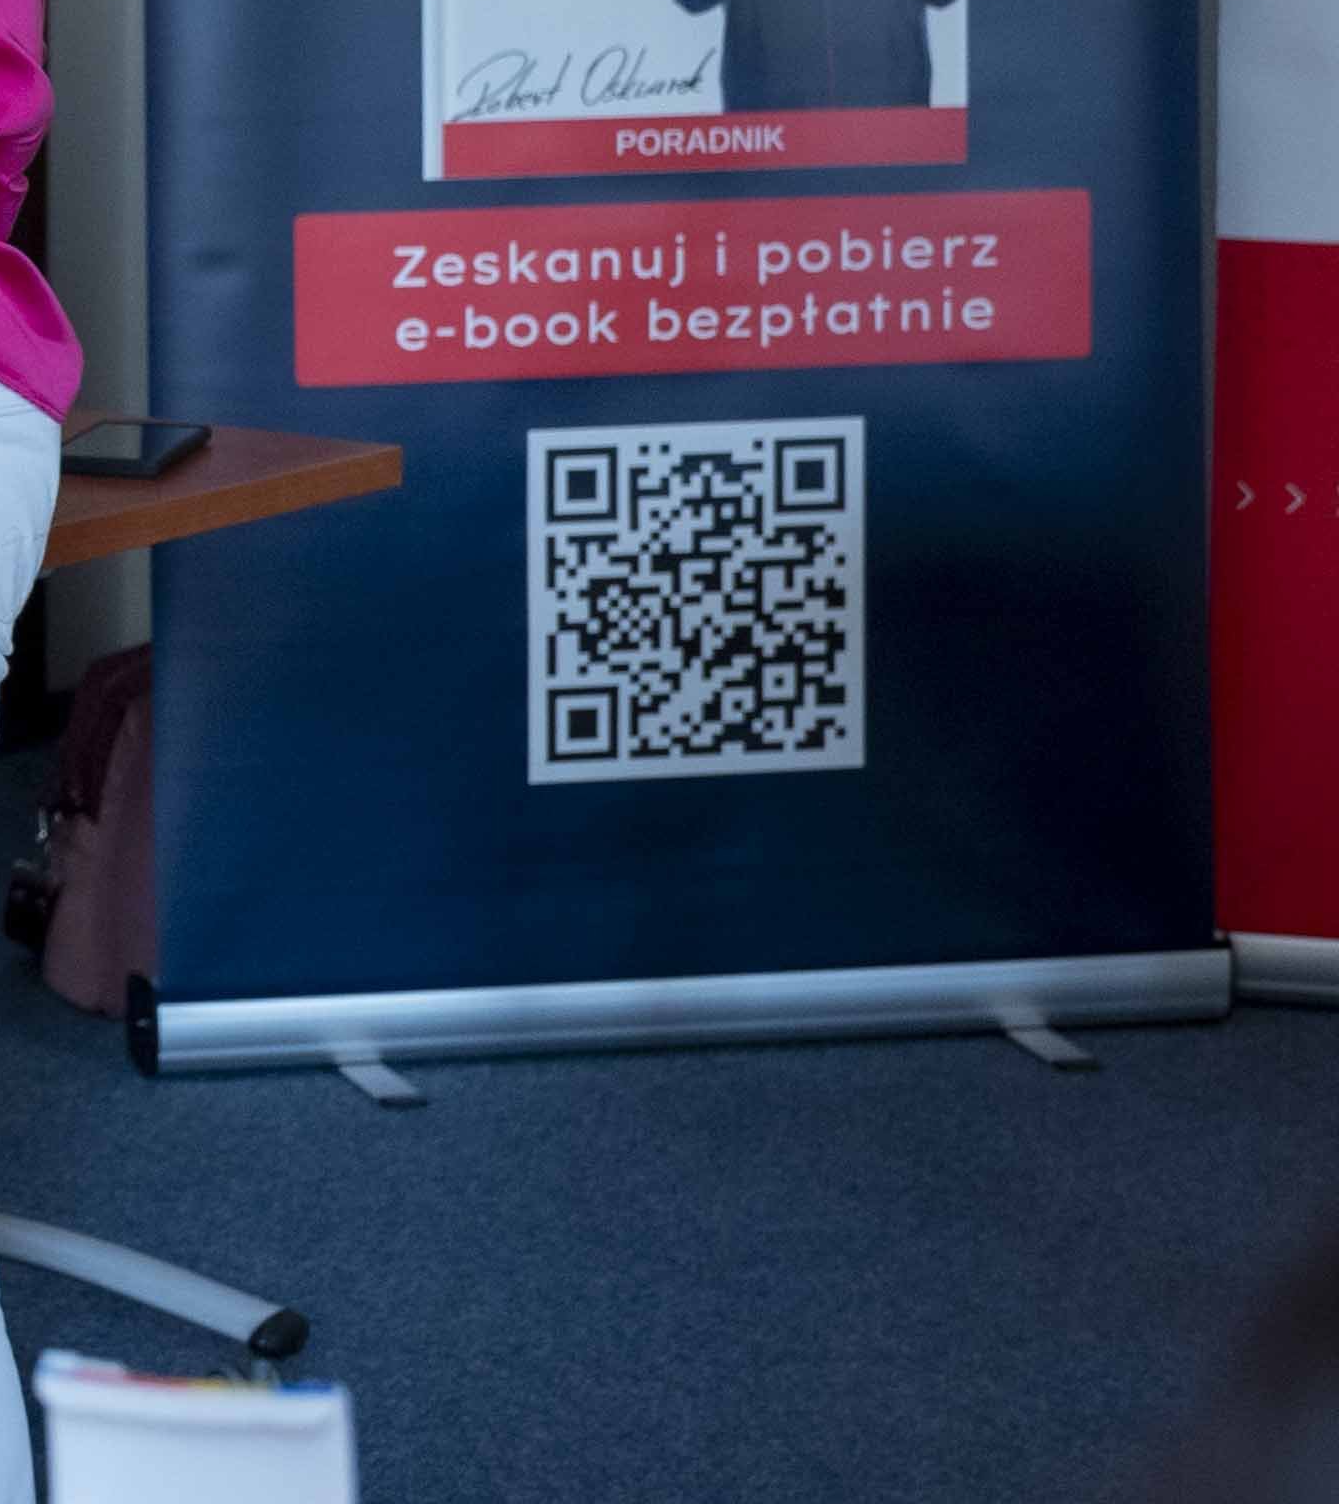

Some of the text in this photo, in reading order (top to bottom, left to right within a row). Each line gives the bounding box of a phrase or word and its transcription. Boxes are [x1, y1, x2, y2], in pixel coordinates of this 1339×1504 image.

[615, 126, 785, 157] PORADNIK
[392, 226, 999, 289] Zeskanuj i pobierz
[395, 288, 996, 352] e-book bezpłatnie
